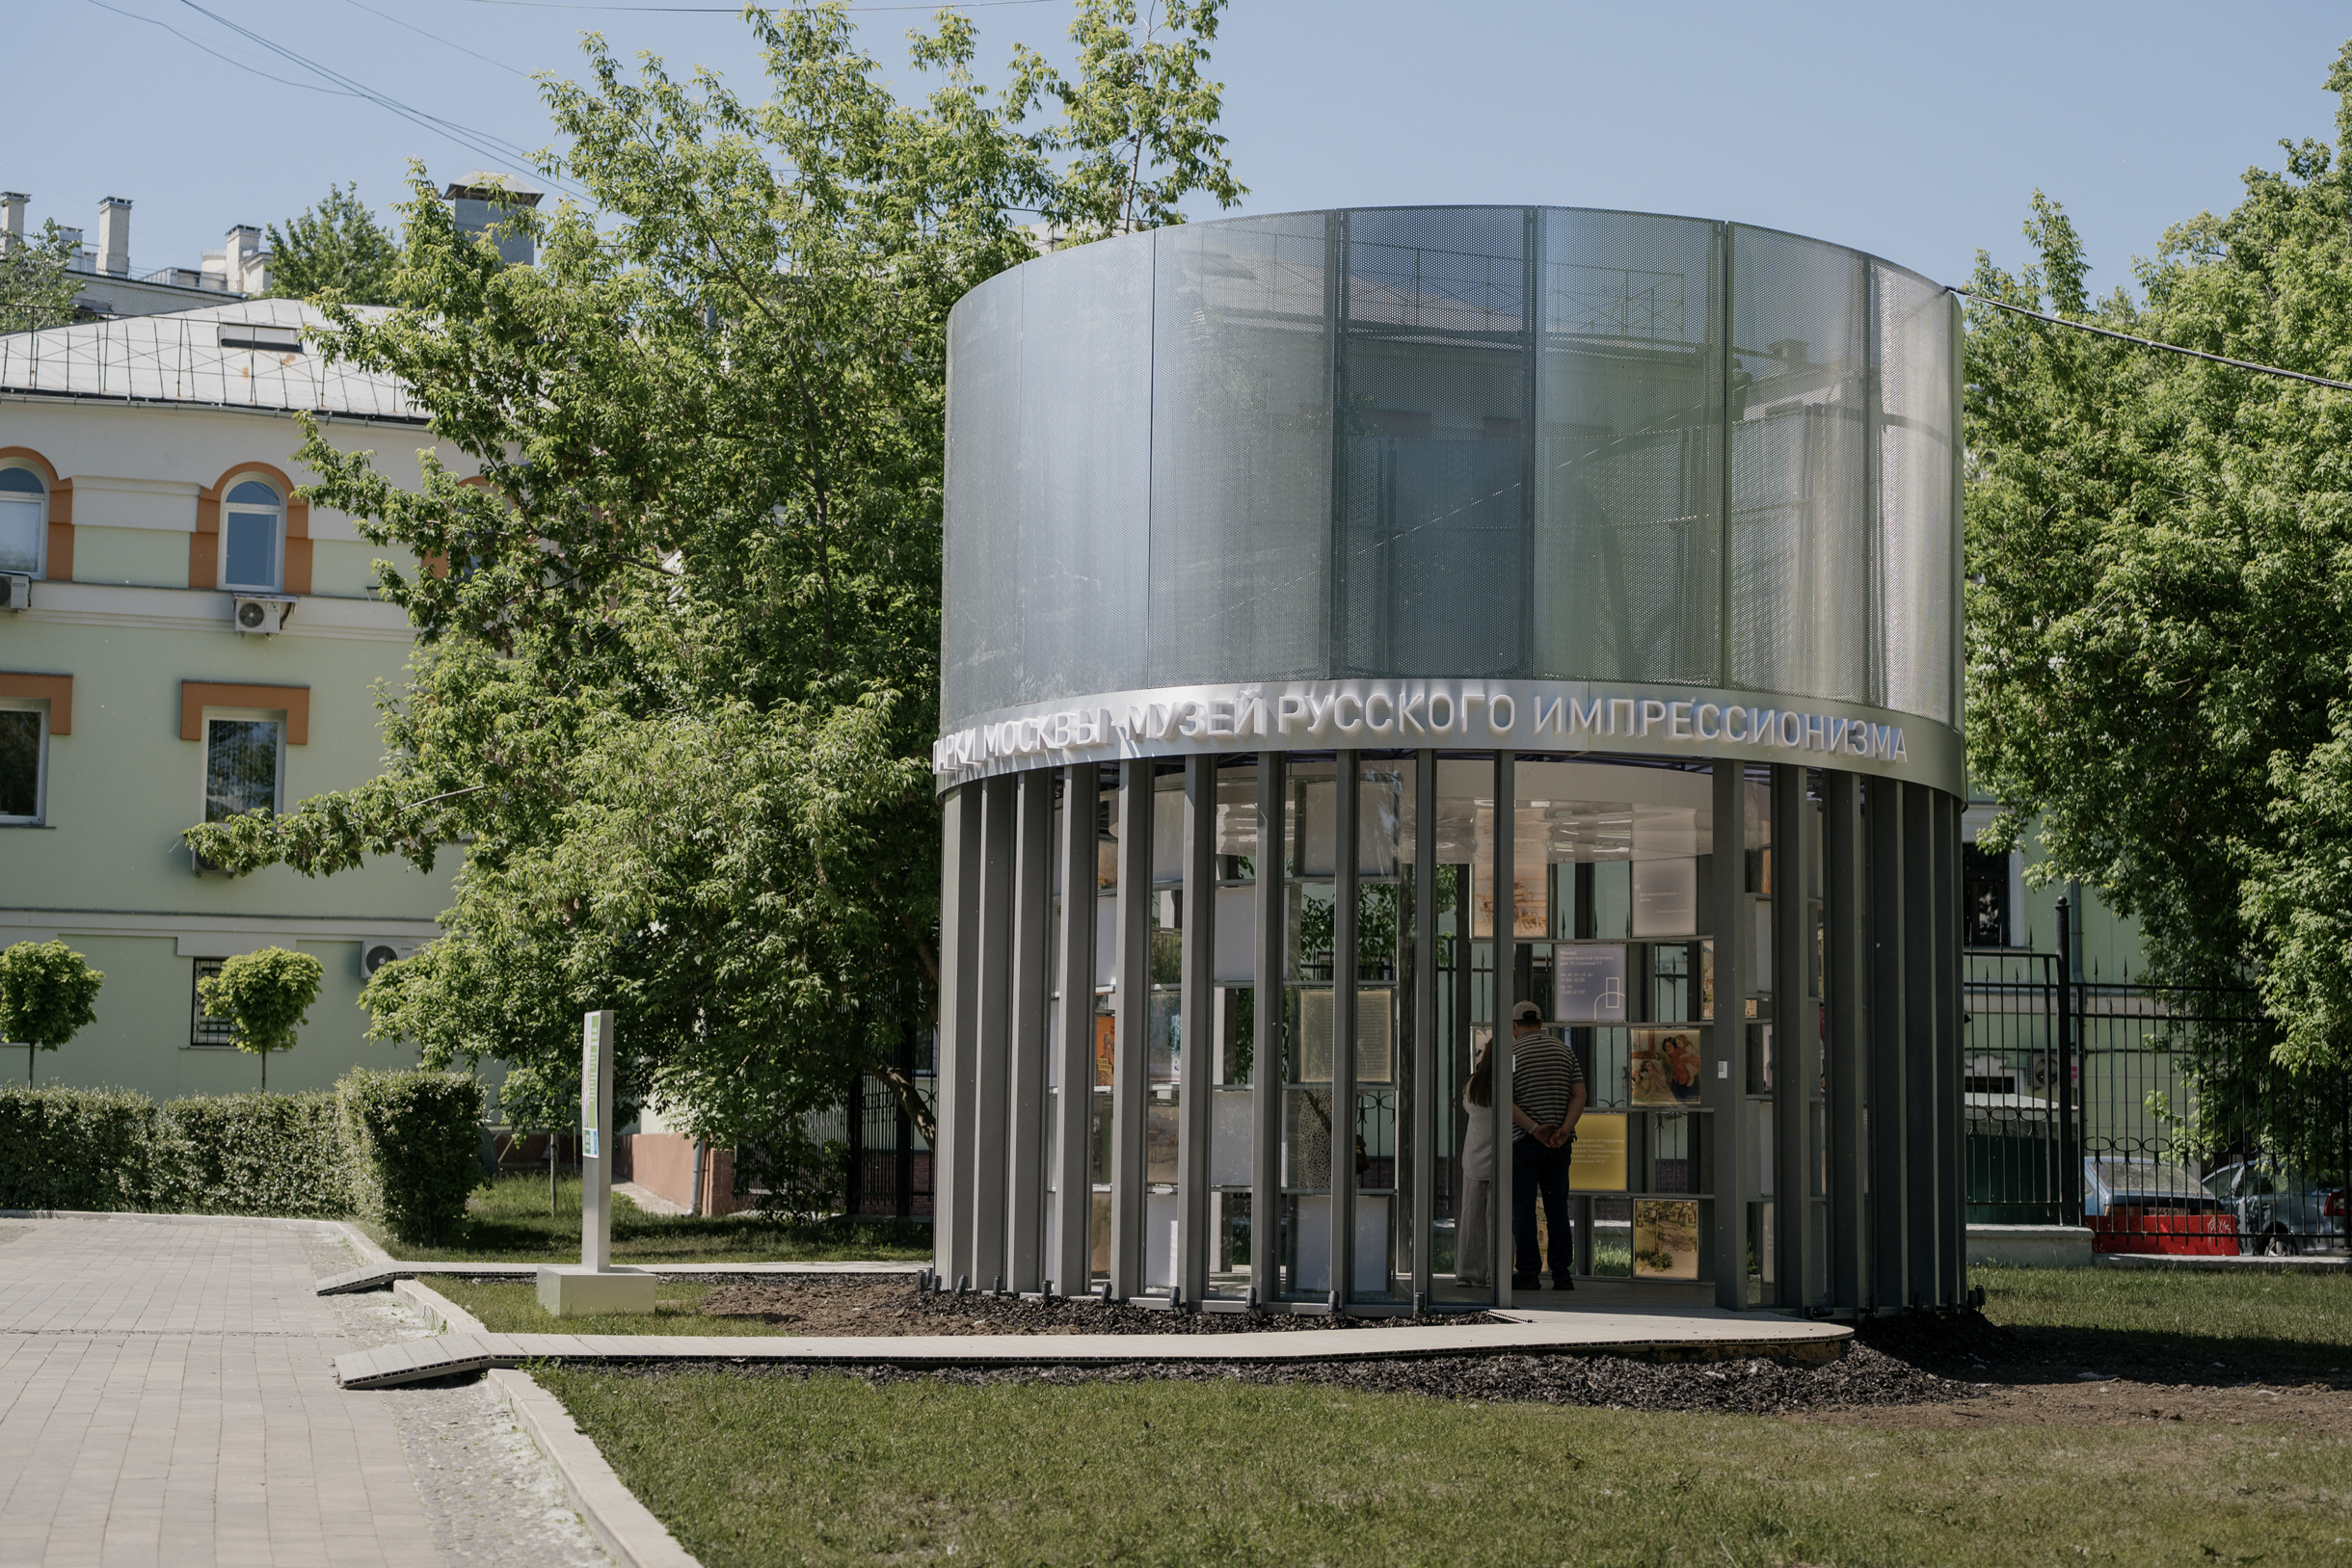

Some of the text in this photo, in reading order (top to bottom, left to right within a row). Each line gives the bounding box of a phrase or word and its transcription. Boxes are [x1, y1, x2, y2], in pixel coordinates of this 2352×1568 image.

[933, 728, 983, 775] ПАРКИ
[983, 708, 1109, 759] МОСКВЫ
[1126, 689, 1267, 741] МУЗЕЙ
[1278, 693, 1516, 733] РУССКОГО
[1534, 695, 1909, 763] ИМПРЕССИОНИЗМА
